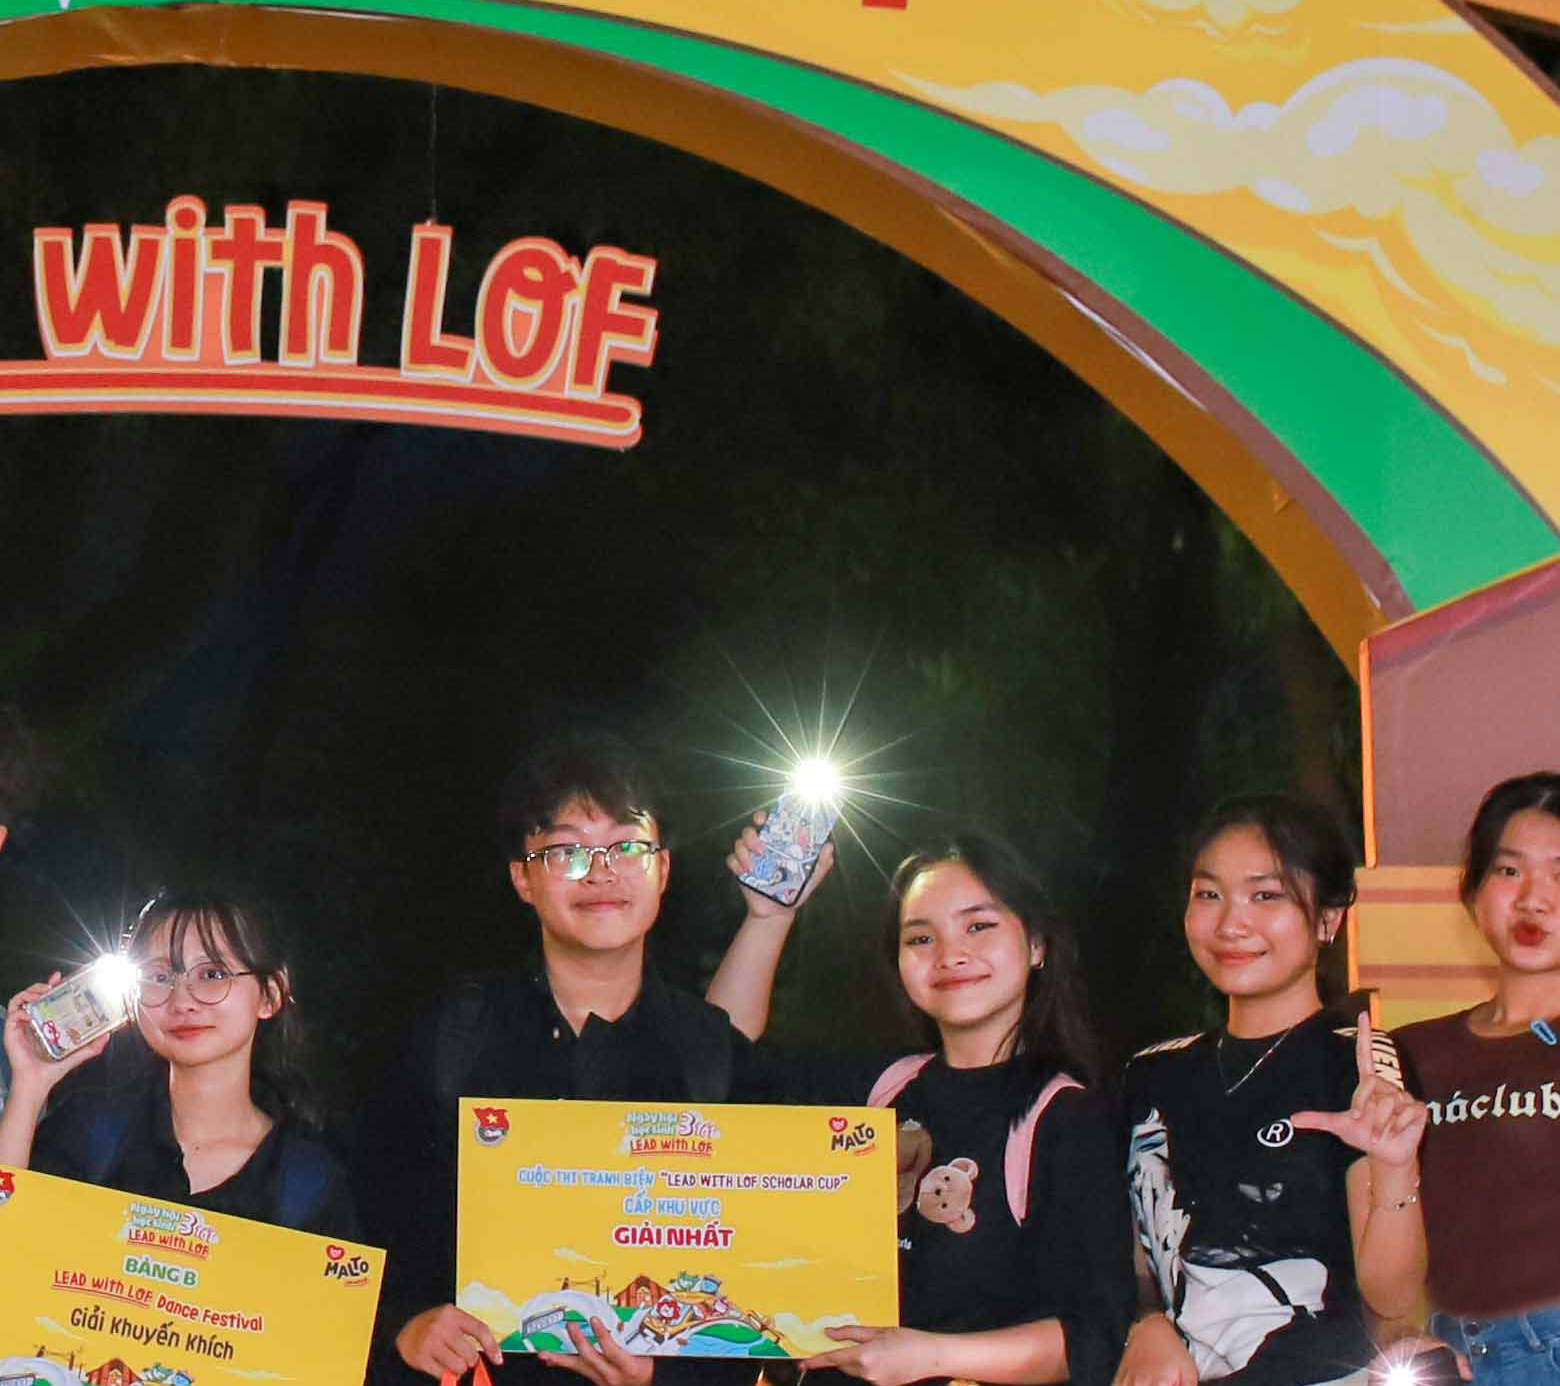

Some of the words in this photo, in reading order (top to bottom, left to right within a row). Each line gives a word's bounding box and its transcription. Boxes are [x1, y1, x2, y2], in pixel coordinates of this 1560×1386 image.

[34, 198, 365, 365] with
[402, 223, 658, 393] LOF
[630, 1138, 657, 1151] LEAD
[700, 1173, 733, 1189] WITH
[736, 1174, 759, 1189] LOF
[761, 1174, 814, 1190] SCHOLAR
[657, 1196, 687, 1215] KHU
[128, 1228, 156, 1243] LEAD
[667, 1219, 734, 1248] NHẤT
[183, 1270, 197, 1286] B
[323, 1255, 370, 1280] MALTO
[54, 1269, 87, 1288] LEAD
[91, 1277, 124, 1296] with
[156, 1294, 199, 1321] Dance
[203, 1309, 264, 1332] Festival
[69, 1303, 106, 1333] Giải
